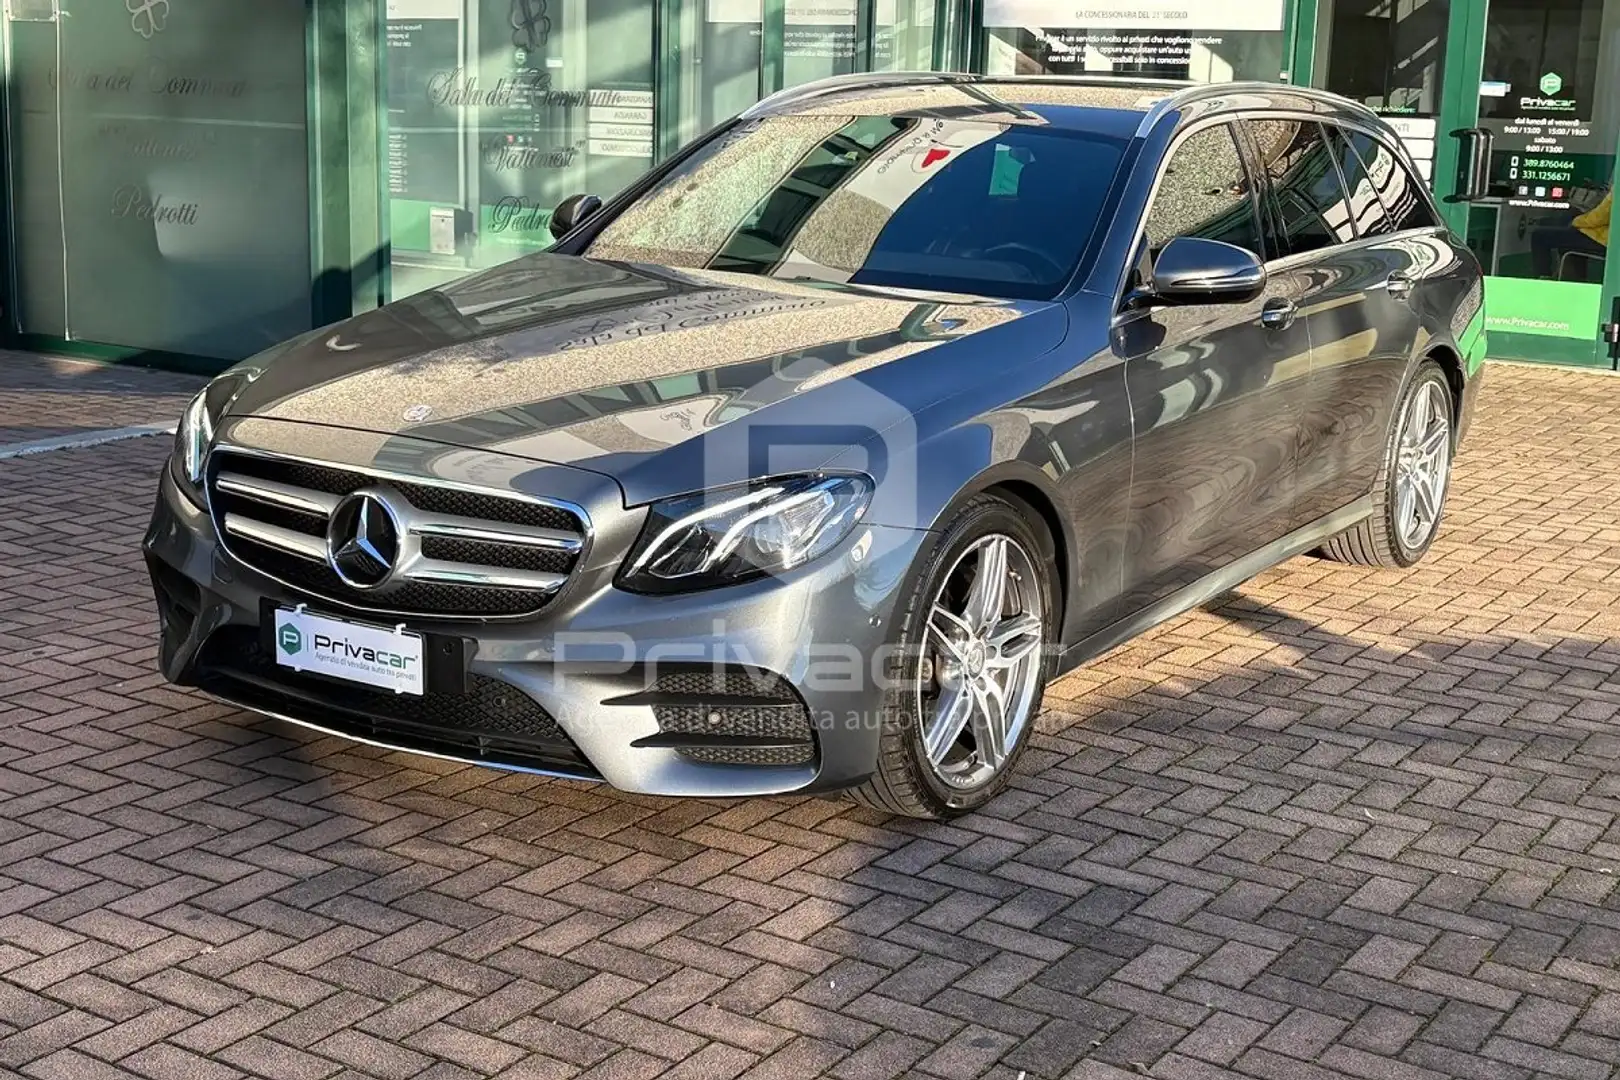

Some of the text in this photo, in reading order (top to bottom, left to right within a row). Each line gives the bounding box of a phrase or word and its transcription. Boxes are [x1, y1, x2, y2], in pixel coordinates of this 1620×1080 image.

[1138, 10, 1150, 18] DEL
[1163, 10, 1188, 19] SECOLO
[1150, 36, 1163, 44] che
[1520, 97, 1576, 107] Privacar
[1523, 159, 1574, 169] 389.8760464
[1522, 170, 1571, 181] 331.1256671
[314, 634, 416, 669] Privacar
